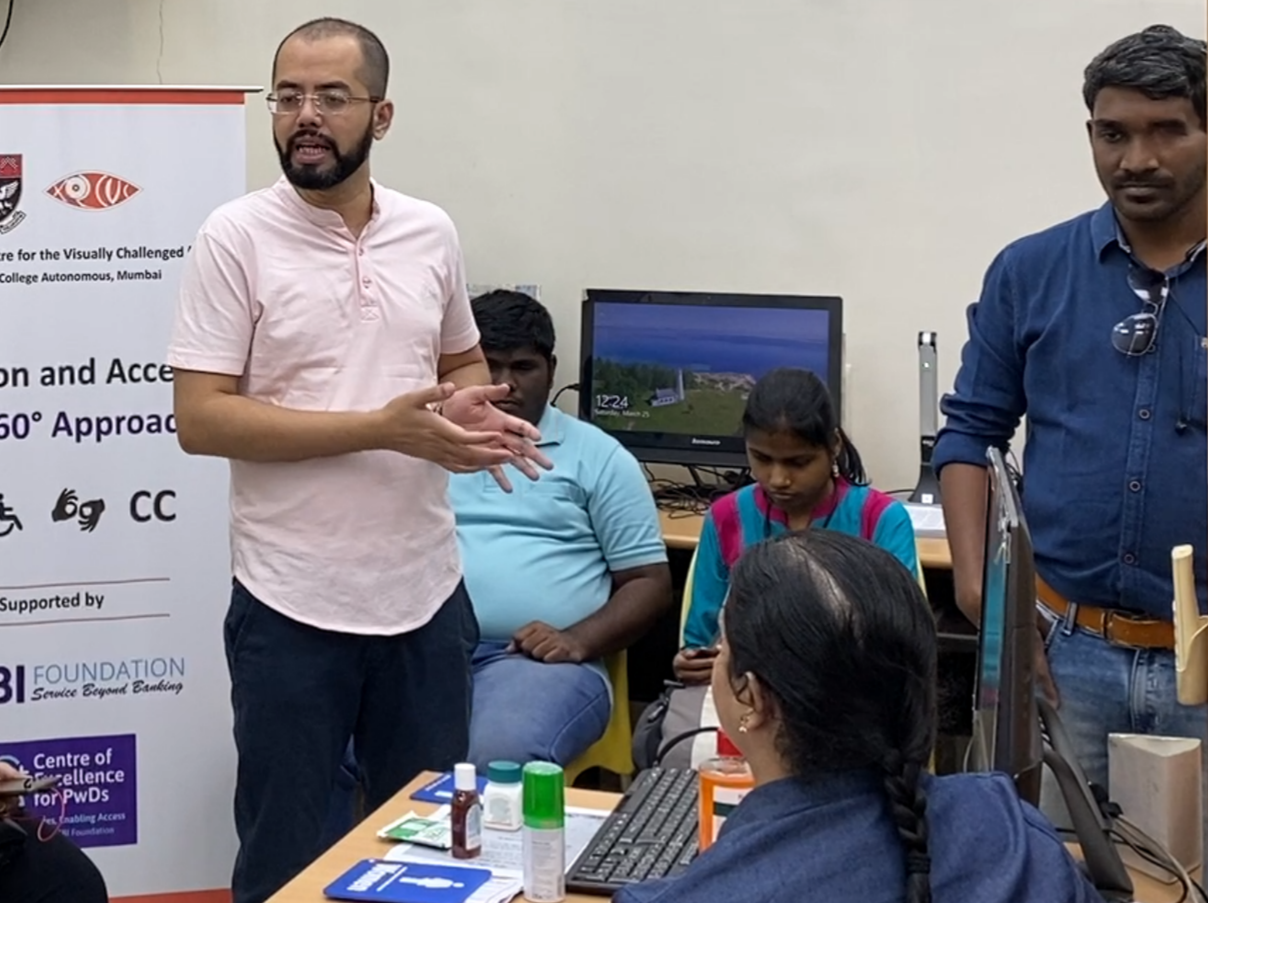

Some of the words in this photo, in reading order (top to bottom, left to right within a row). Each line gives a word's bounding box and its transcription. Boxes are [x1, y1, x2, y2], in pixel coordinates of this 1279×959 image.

[17, 248, 36, 261] for
[39, 248, 61, 261] the
[63, 247, 113, 262] Visually
[116, 245, 185, 261] Challenged
[41, 271, 115, 283] Autonomous,
[116, 269, 163, 281] Mumbai
[40, 357, 96, 387] and
[595, 394, 629, 409] 12:24
[129, 489, 177, 523] CC
[85, 591, 105, 609] by
[33, 656, 186, 686] FOUNDATION
[30, 687, 78, 702] Service
[82, 683, 128, 700] Beyond
[132, 679, 184, 695] Banking
[33, 752, 90, 770] Centre
[94, 747, 113, 765] of
[62, 786, 110, 805] PwDs
[97, 812, 127, 822] Access
